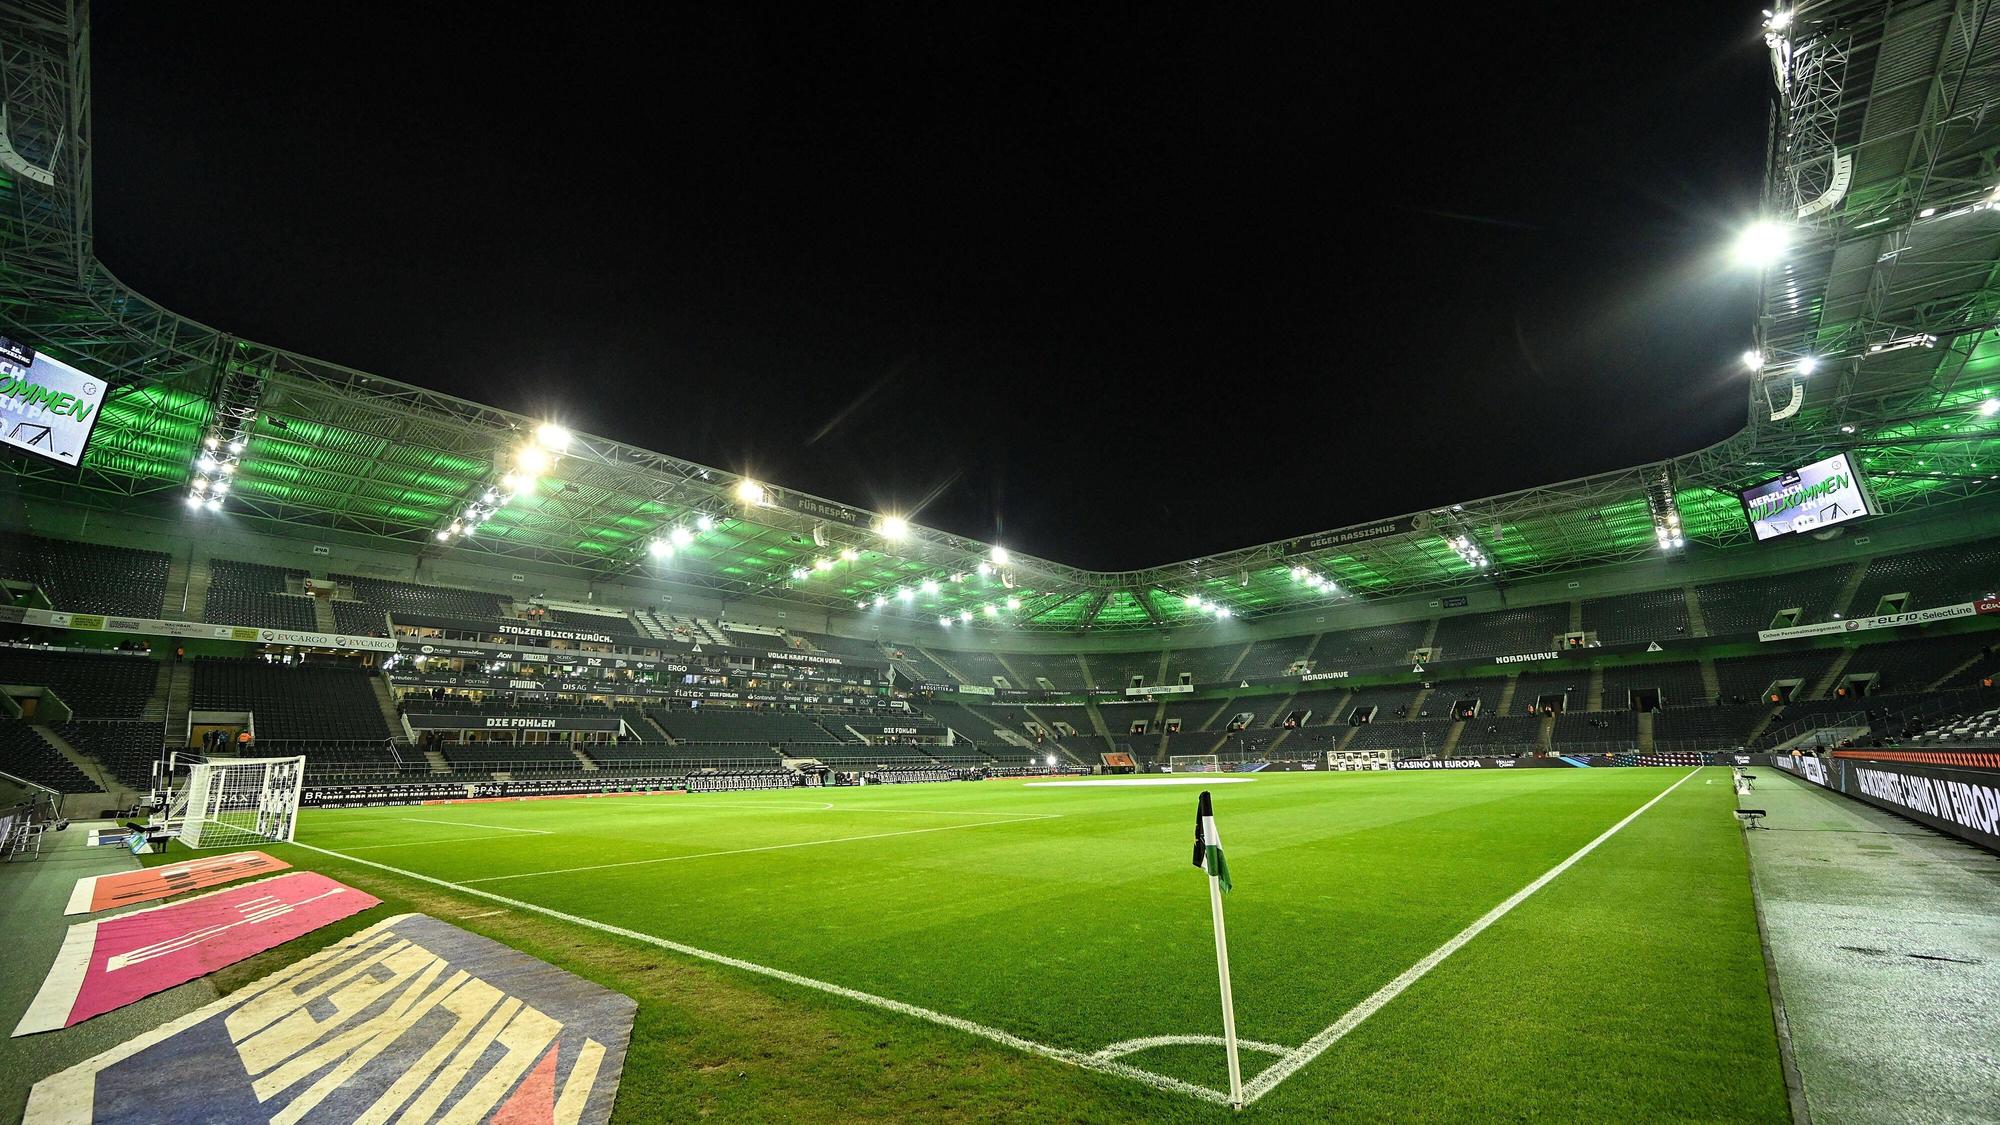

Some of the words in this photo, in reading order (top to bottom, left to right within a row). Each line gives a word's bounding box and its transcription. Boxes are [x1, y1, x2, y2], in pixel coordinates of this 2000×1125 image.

[1747, 472, 1849, 523] WILLKOMMEN
[1749, 483, 1803, 508] HERZLICH
[799, 499, 817, 511] FÜR
[818, 506, 857, 521] RESPEKT
[1310, 535, 1339, 548] GEGEN
[1340, 524, 1396, 542] RASSISMUS
[1922, 606, 1972, 620] SelectLine
[499, 625, 543, 637] STOLZER
[544, 630, 574, 639] BLICK
[575, 632, 613, 643] ZURÜCK.
[768, 652, 788, 660] VOLLE
[788, 654, 808, 662] KRAFT
[1495, 651, 1559, 664] NORDKURVE
[667, 664, 688, 672] ERGO
[1302, 671, 1349, 681] NORDKURVE
[509, 679, 536, 689] PUMA
[562, 683, 576, 691] DIS
[674, 688, 704, 698] flatex
[486, 718, 509, 727] DIE
[511, 718, 556, 728] FOHLEN
[1396, 759, 1431, 769] CASINO
[1432, 759, 1443, 769] IN
[1444, 759, 1482, 769] EUROPA
[1900, 773, 1938, 817] CASINO
[1933, 778, 1954, 822] IN
